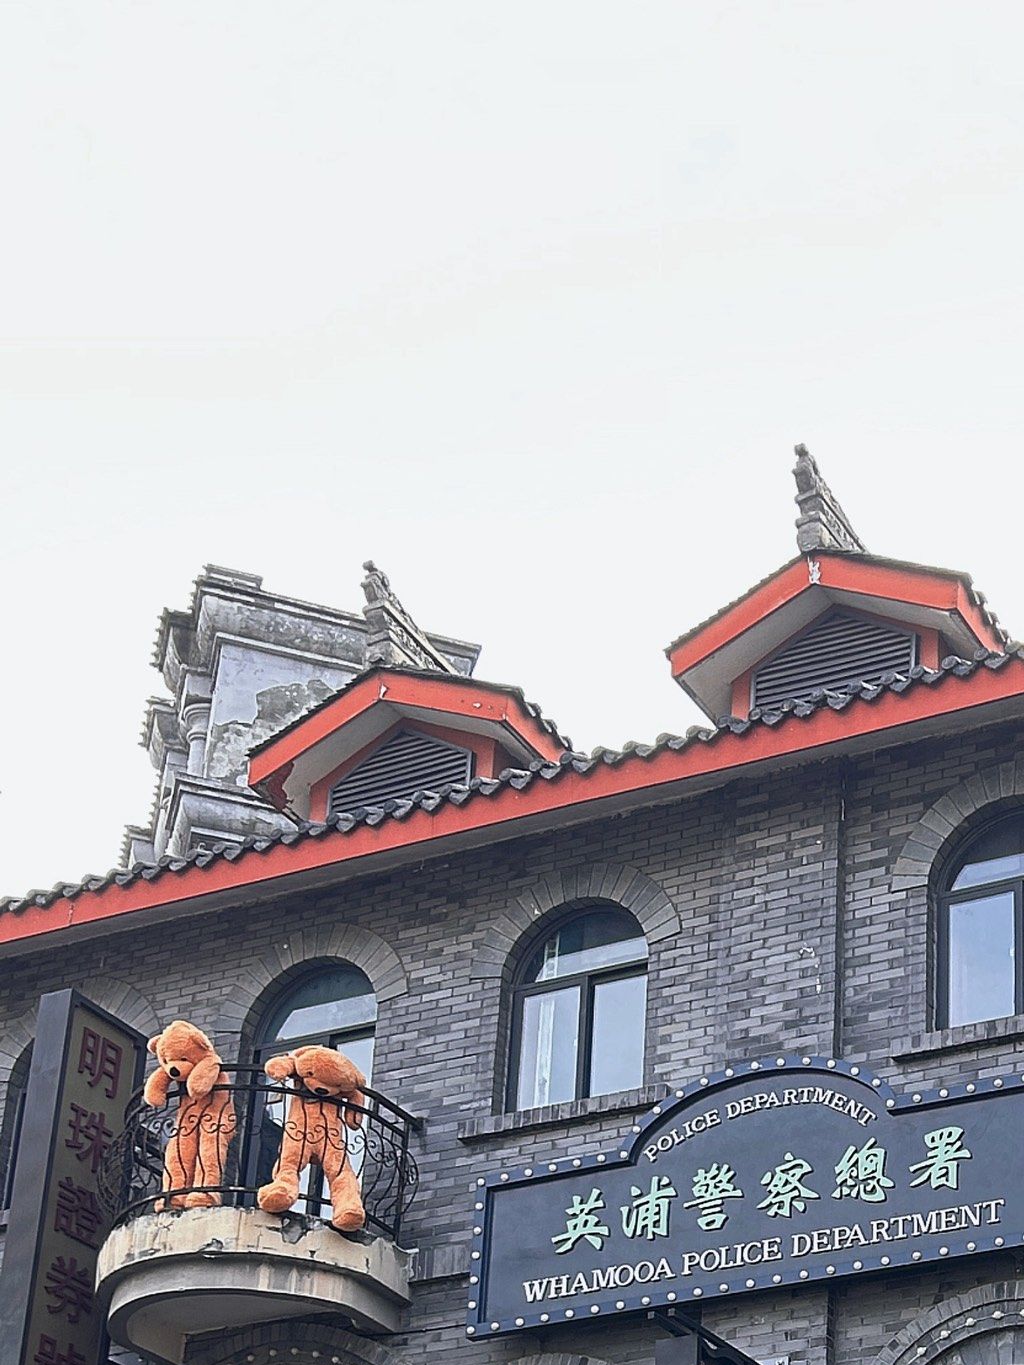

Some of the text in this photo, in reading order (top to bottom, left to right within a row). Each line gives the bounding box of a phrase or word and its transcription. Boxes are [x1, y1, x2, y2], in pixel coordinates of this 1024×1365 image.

[643, 1087, 877, 1163] POLICE DEPARTMENT
[551, 1125, 972, 1255] 英浦警察總署
[522, 1199, 1006, 1304] WHAMOOA POLICE DEPARTMENT
